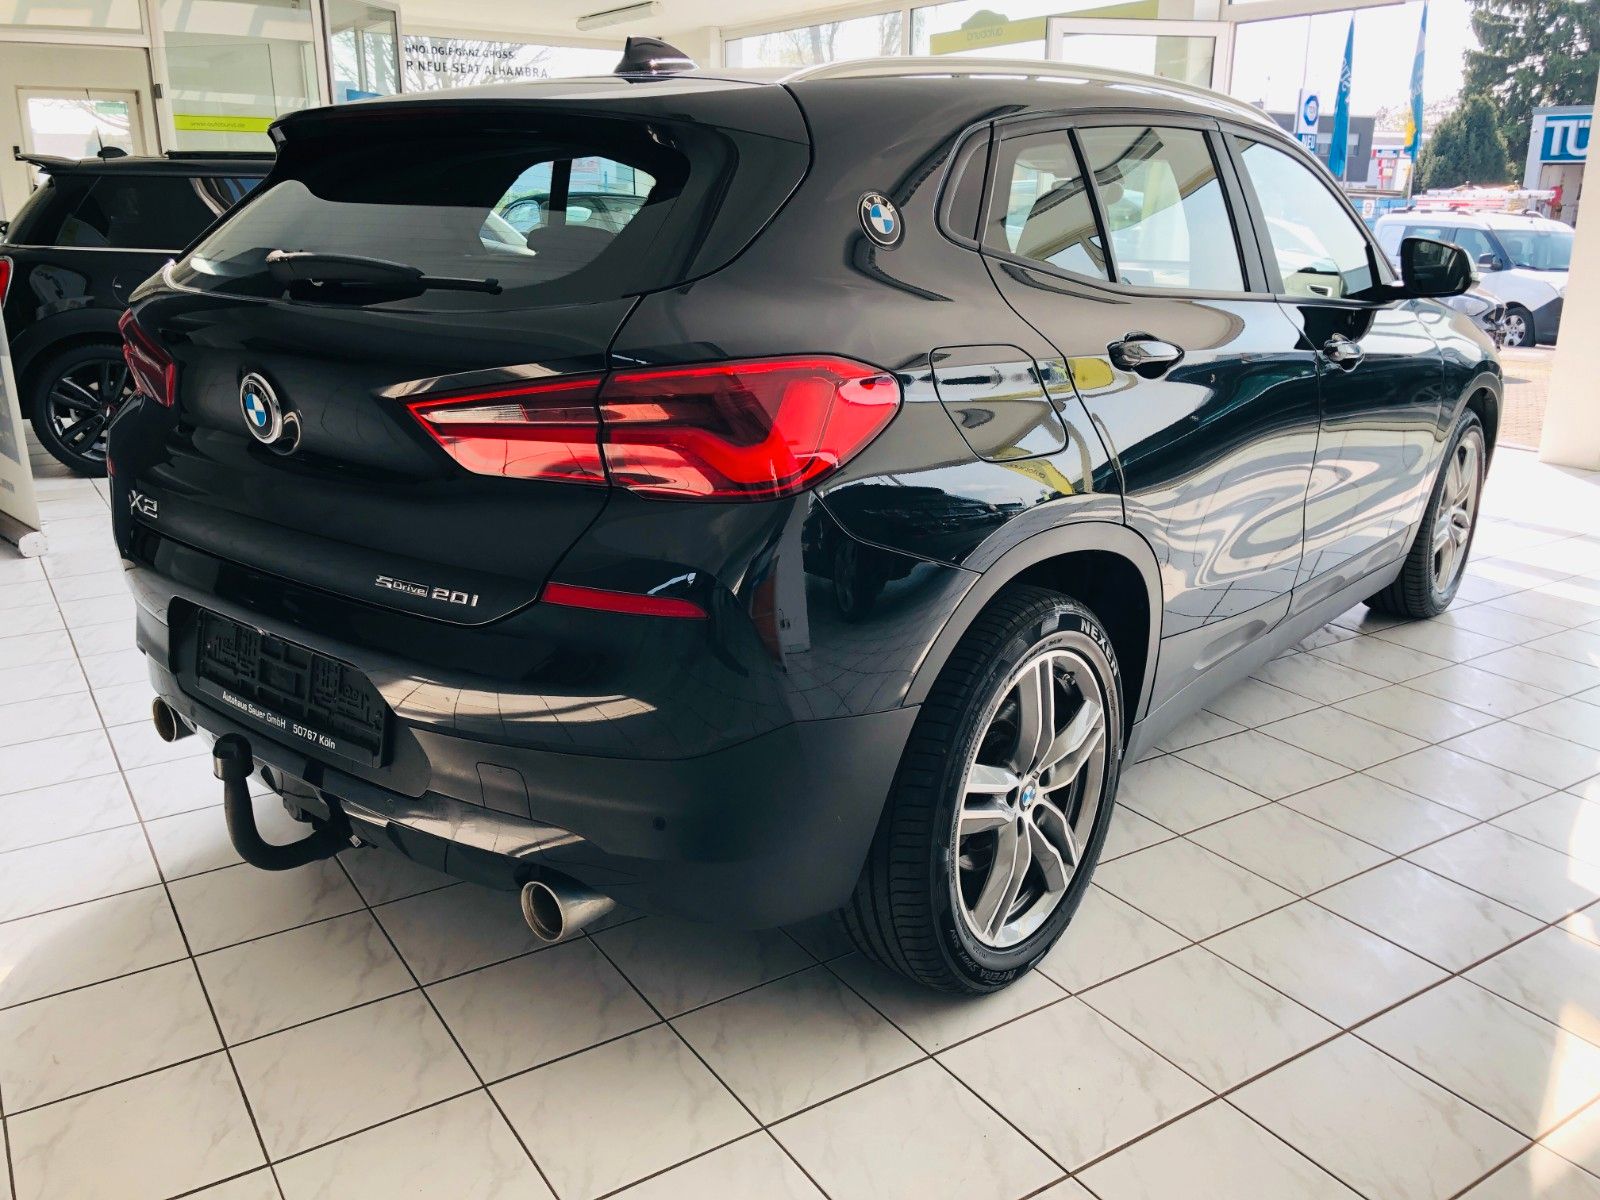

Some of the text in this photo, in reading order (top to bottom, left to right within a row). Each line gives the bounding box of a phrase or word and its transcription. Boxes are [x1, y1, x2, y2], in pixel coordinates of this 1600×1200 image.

[455, 47, 480, 57] GANZ
[418, 61, 448, 72] NEUE
[451, 63, 480, 74] SEAT
[484, 65, 548, 79] ALHAMBRA
[129, 489, 158, 519] X2
[1081, 618, 1118, 677] NEXEN
[222, 691, 336, 750] Autohaus Sauer GmbH 50767 Köln
